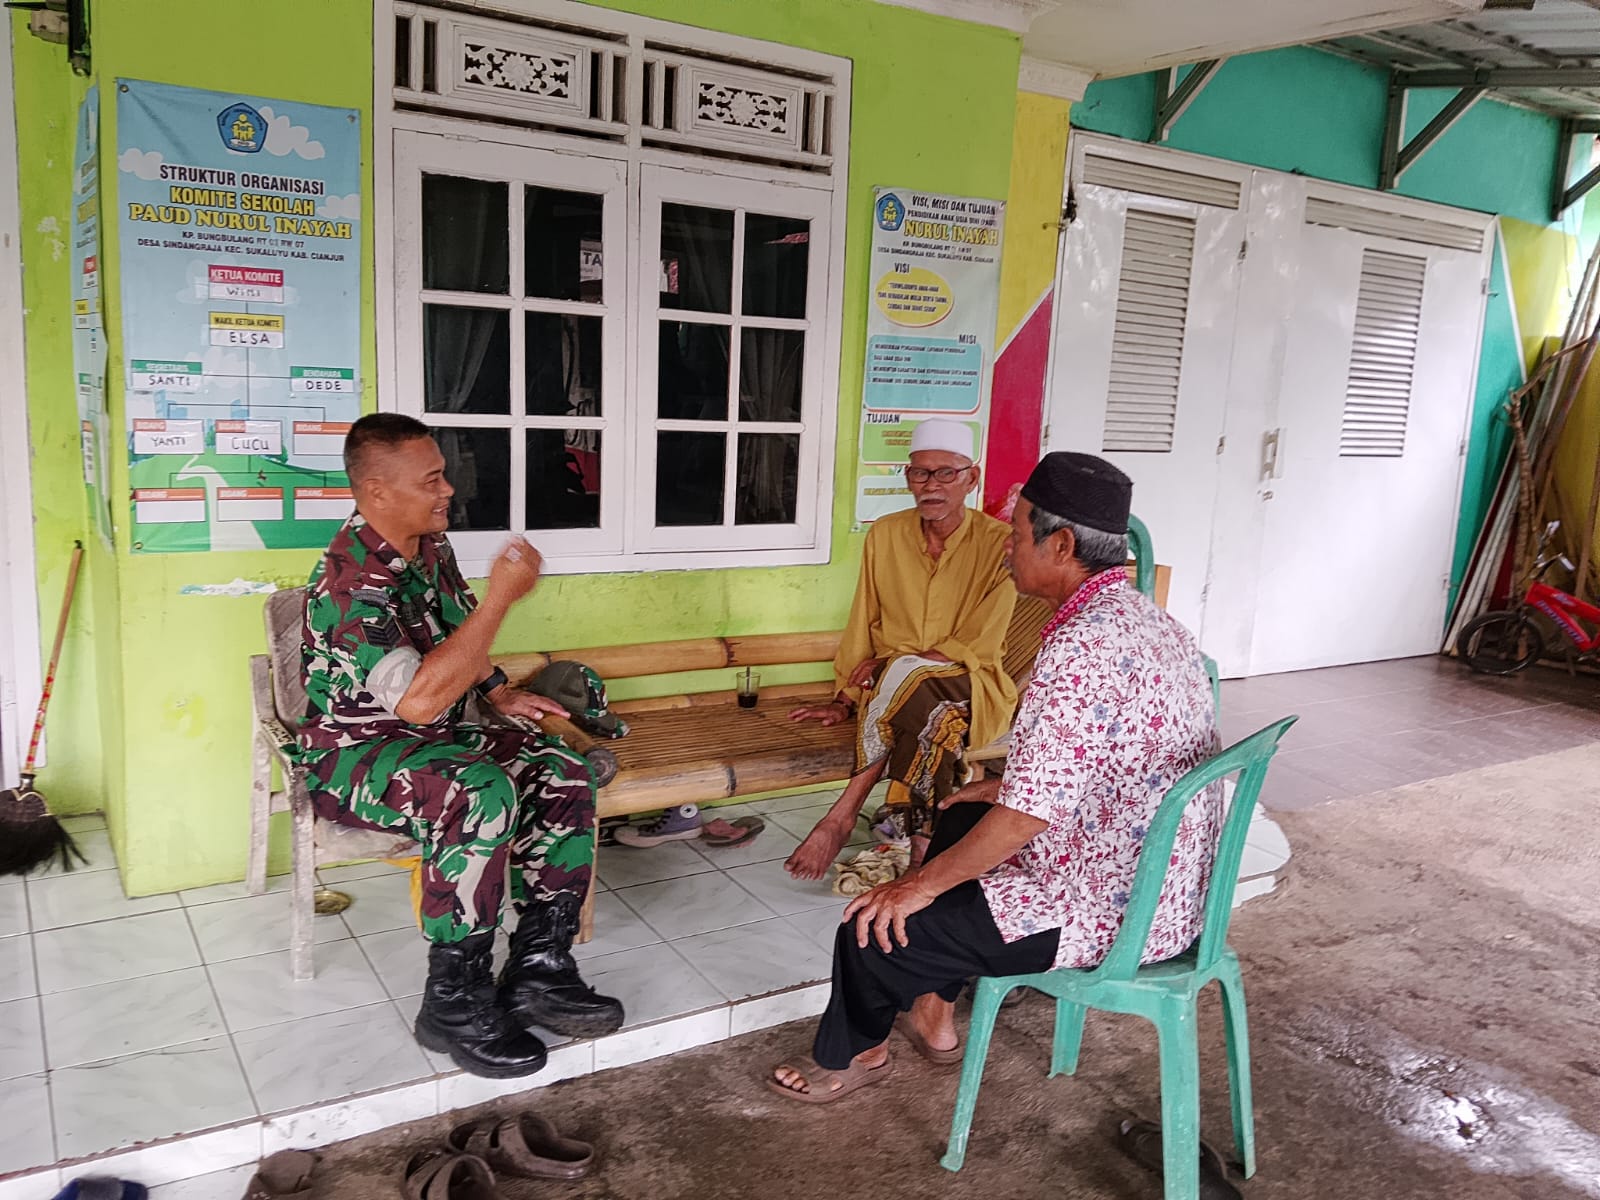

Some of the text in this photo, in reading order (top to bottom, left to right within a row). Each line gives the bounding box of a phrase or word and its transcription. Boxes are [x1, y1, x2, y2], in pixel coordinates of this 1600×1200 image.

[160, 164, 324, 195] STRUKTUR ORGANISASI
[170, 186, 315, 216] KOMITE SEKOLAH
[912, 196, 996, 215] VISI, MISI DAN TUJUAN
[128, 202, 352, 239] PAUD NURUL INAYAH
[904, 219, 999, 246] NURUL INAYAH
[138, 238, 160, 247] DESA
[894, 262, 910, 273] VISI
[210, 269, 281, 283] KETUA KOMITE
[230, 332, 270, 345] ELSA
[959, 334, 976, 345] MISI
[149, 374, 190, 386] SANTI
[306, 380, 342, 390] DEDE
[866, 413, 900, 423] TUJUAN
